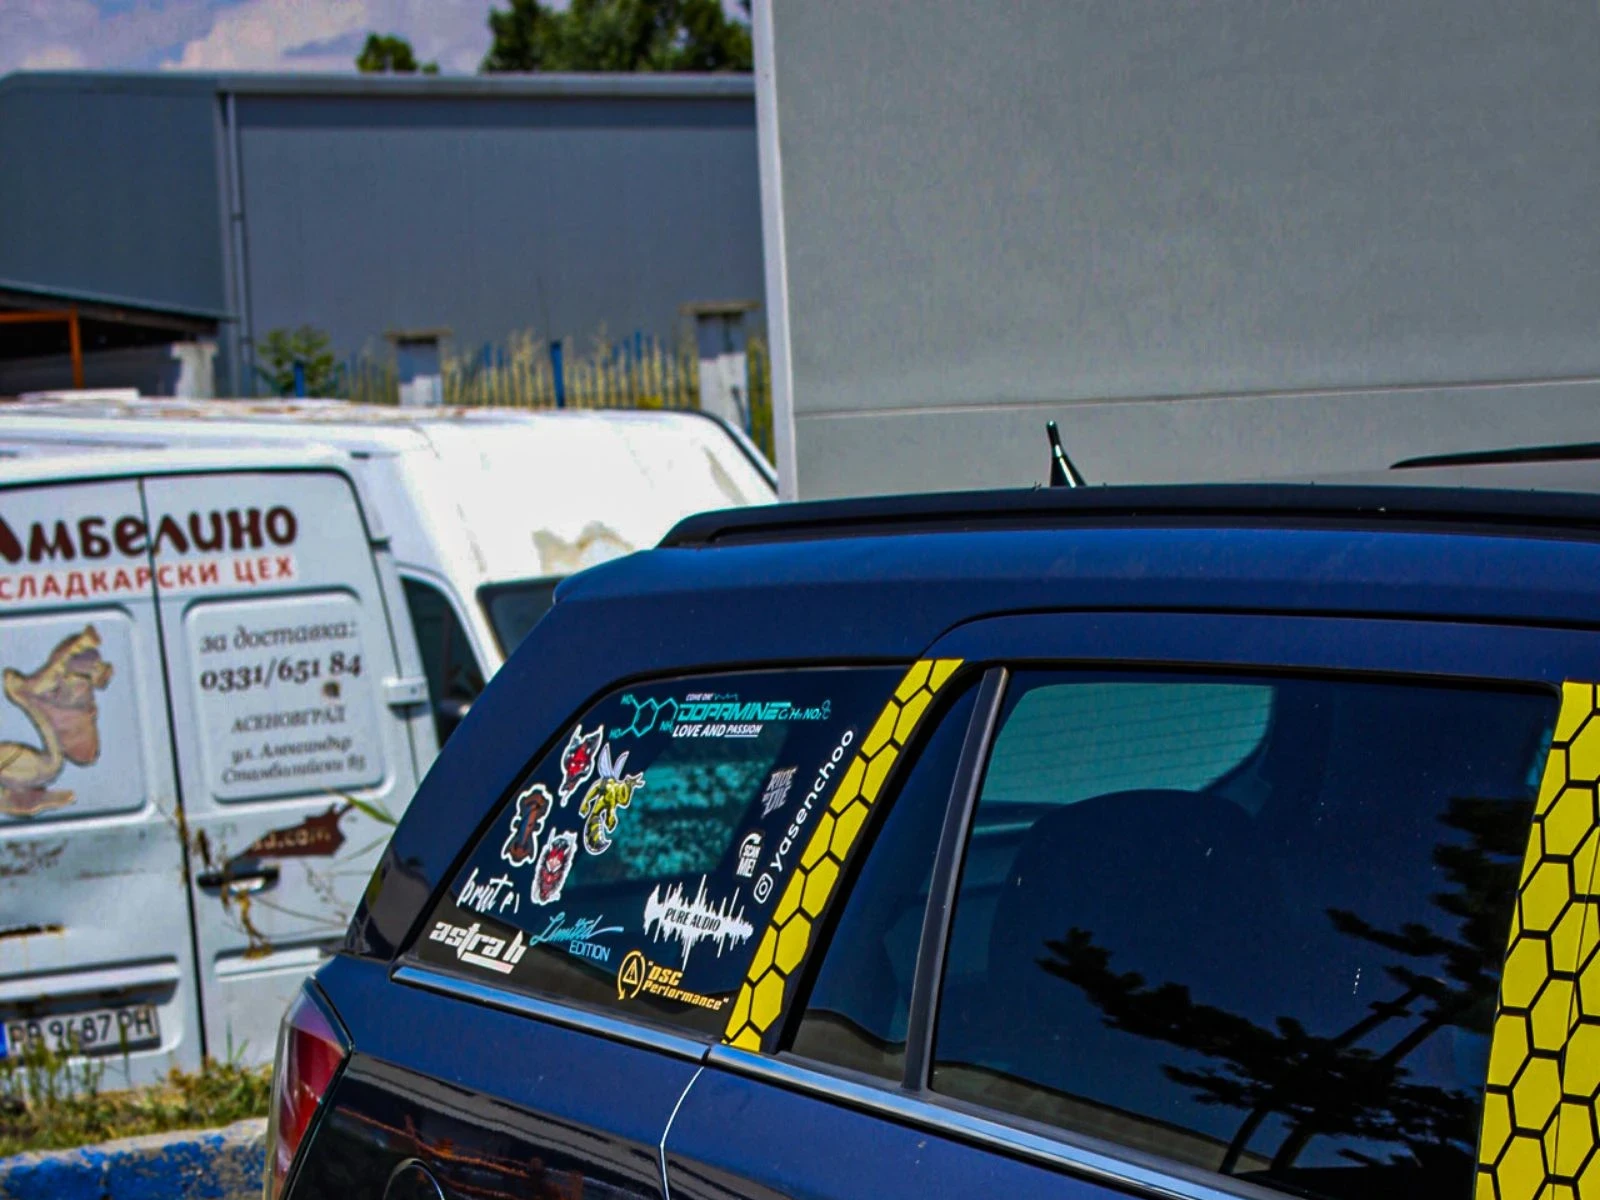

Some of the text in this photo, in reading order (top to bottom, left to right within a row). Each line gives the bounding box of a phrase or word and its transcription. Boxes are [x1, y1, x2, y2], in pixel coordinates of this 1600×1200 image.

[233, 555, 294, 585] ЦЕХ
[201, 622, 357, 652] за доставка:
[200, 651, 362, 693] 0331/651 84
[672, 723, 763, 738] LOVE AND PASSION
[769, 730, 854, 873] yasenchoo
[664, 907, 721, 932] PURE AUDIO
[429, 921, 506, 960] astra
[569, 940, 612, 962] EDITION
